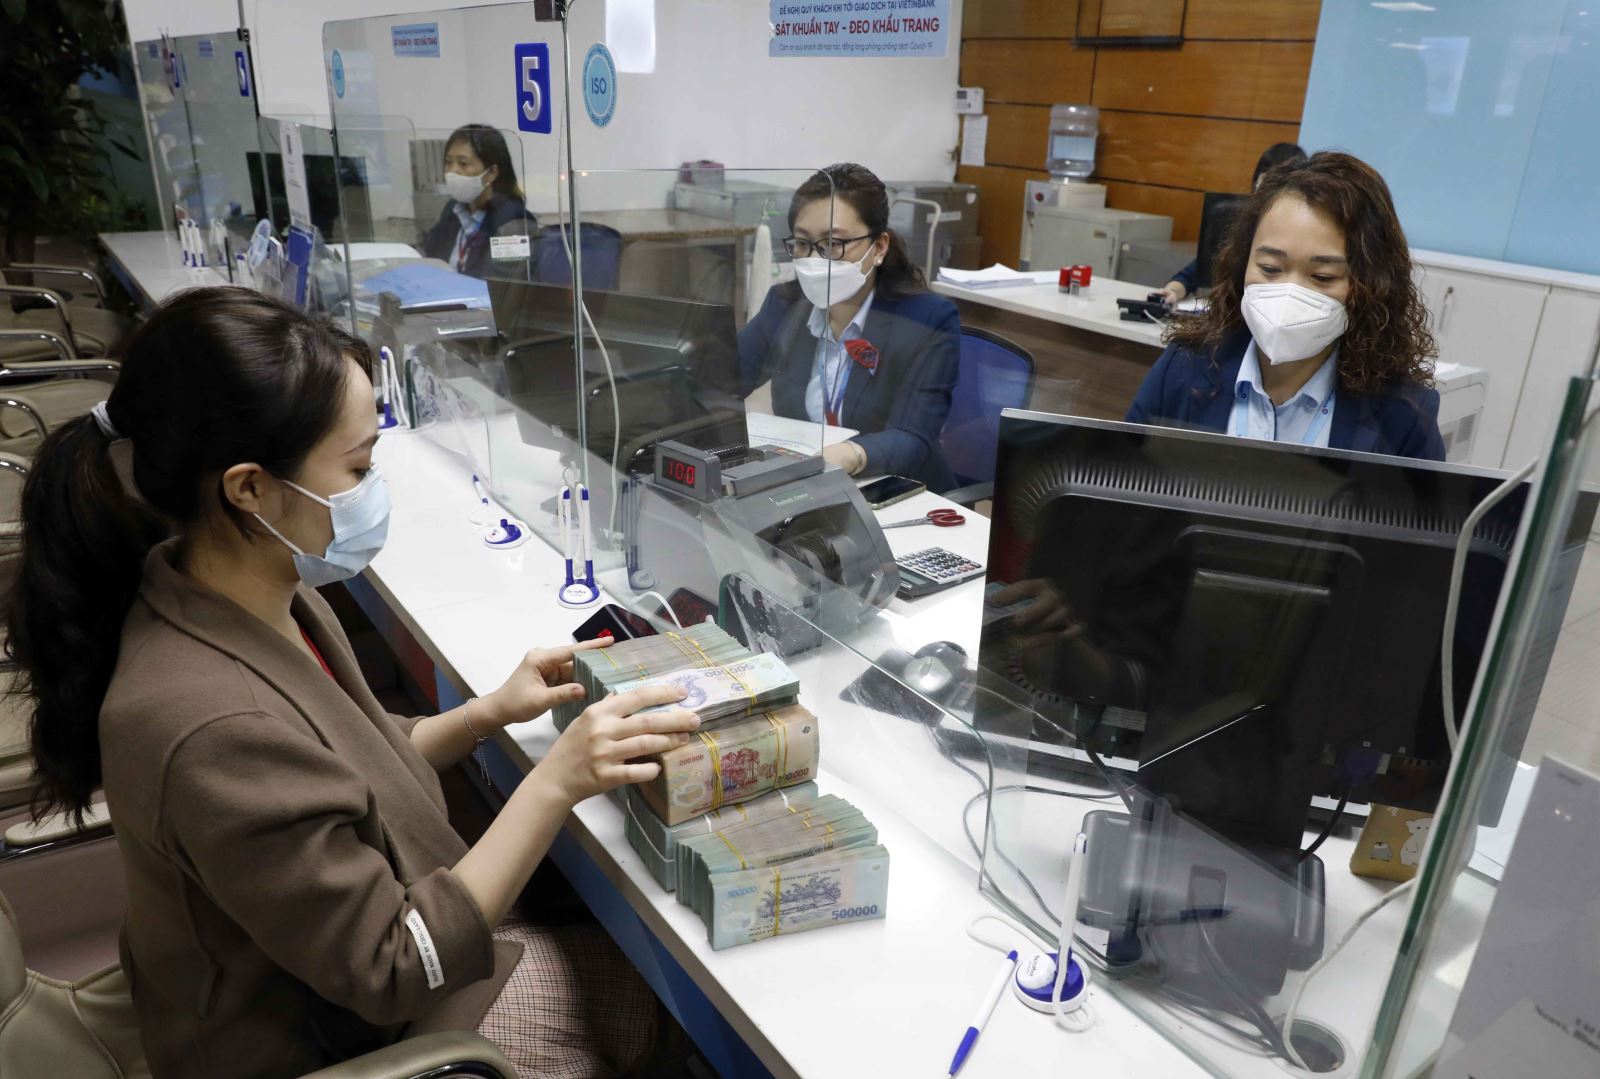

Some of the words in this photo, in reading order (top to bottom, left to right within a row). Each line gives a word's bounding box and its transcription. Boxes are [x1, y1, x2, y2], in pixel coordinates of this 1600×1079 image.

[833, 4, 842, 12] KHI
[855, 1, 870, 12] GIAO
[870, 1, 886, 12] DỊCH
[898, 0, 936, 9] VIETINBANK
[776, 20, 790, 36] SÁT
[792, 16, 821, 36] KHUẨN
[824, 20, 840, 35] TAY
[849, 19, 870, 34] ĐEO
[872, 13, 900, 33] KHẨU
[902, 16, 940, 32] TRANG
[522, 56, 541, 122] 5
[592, 77, 607, 94] ISO
[667, 459, 696, 485] 100
[679, 754, 704, 767] 200000
[832, 904, 878, 920] 500000
